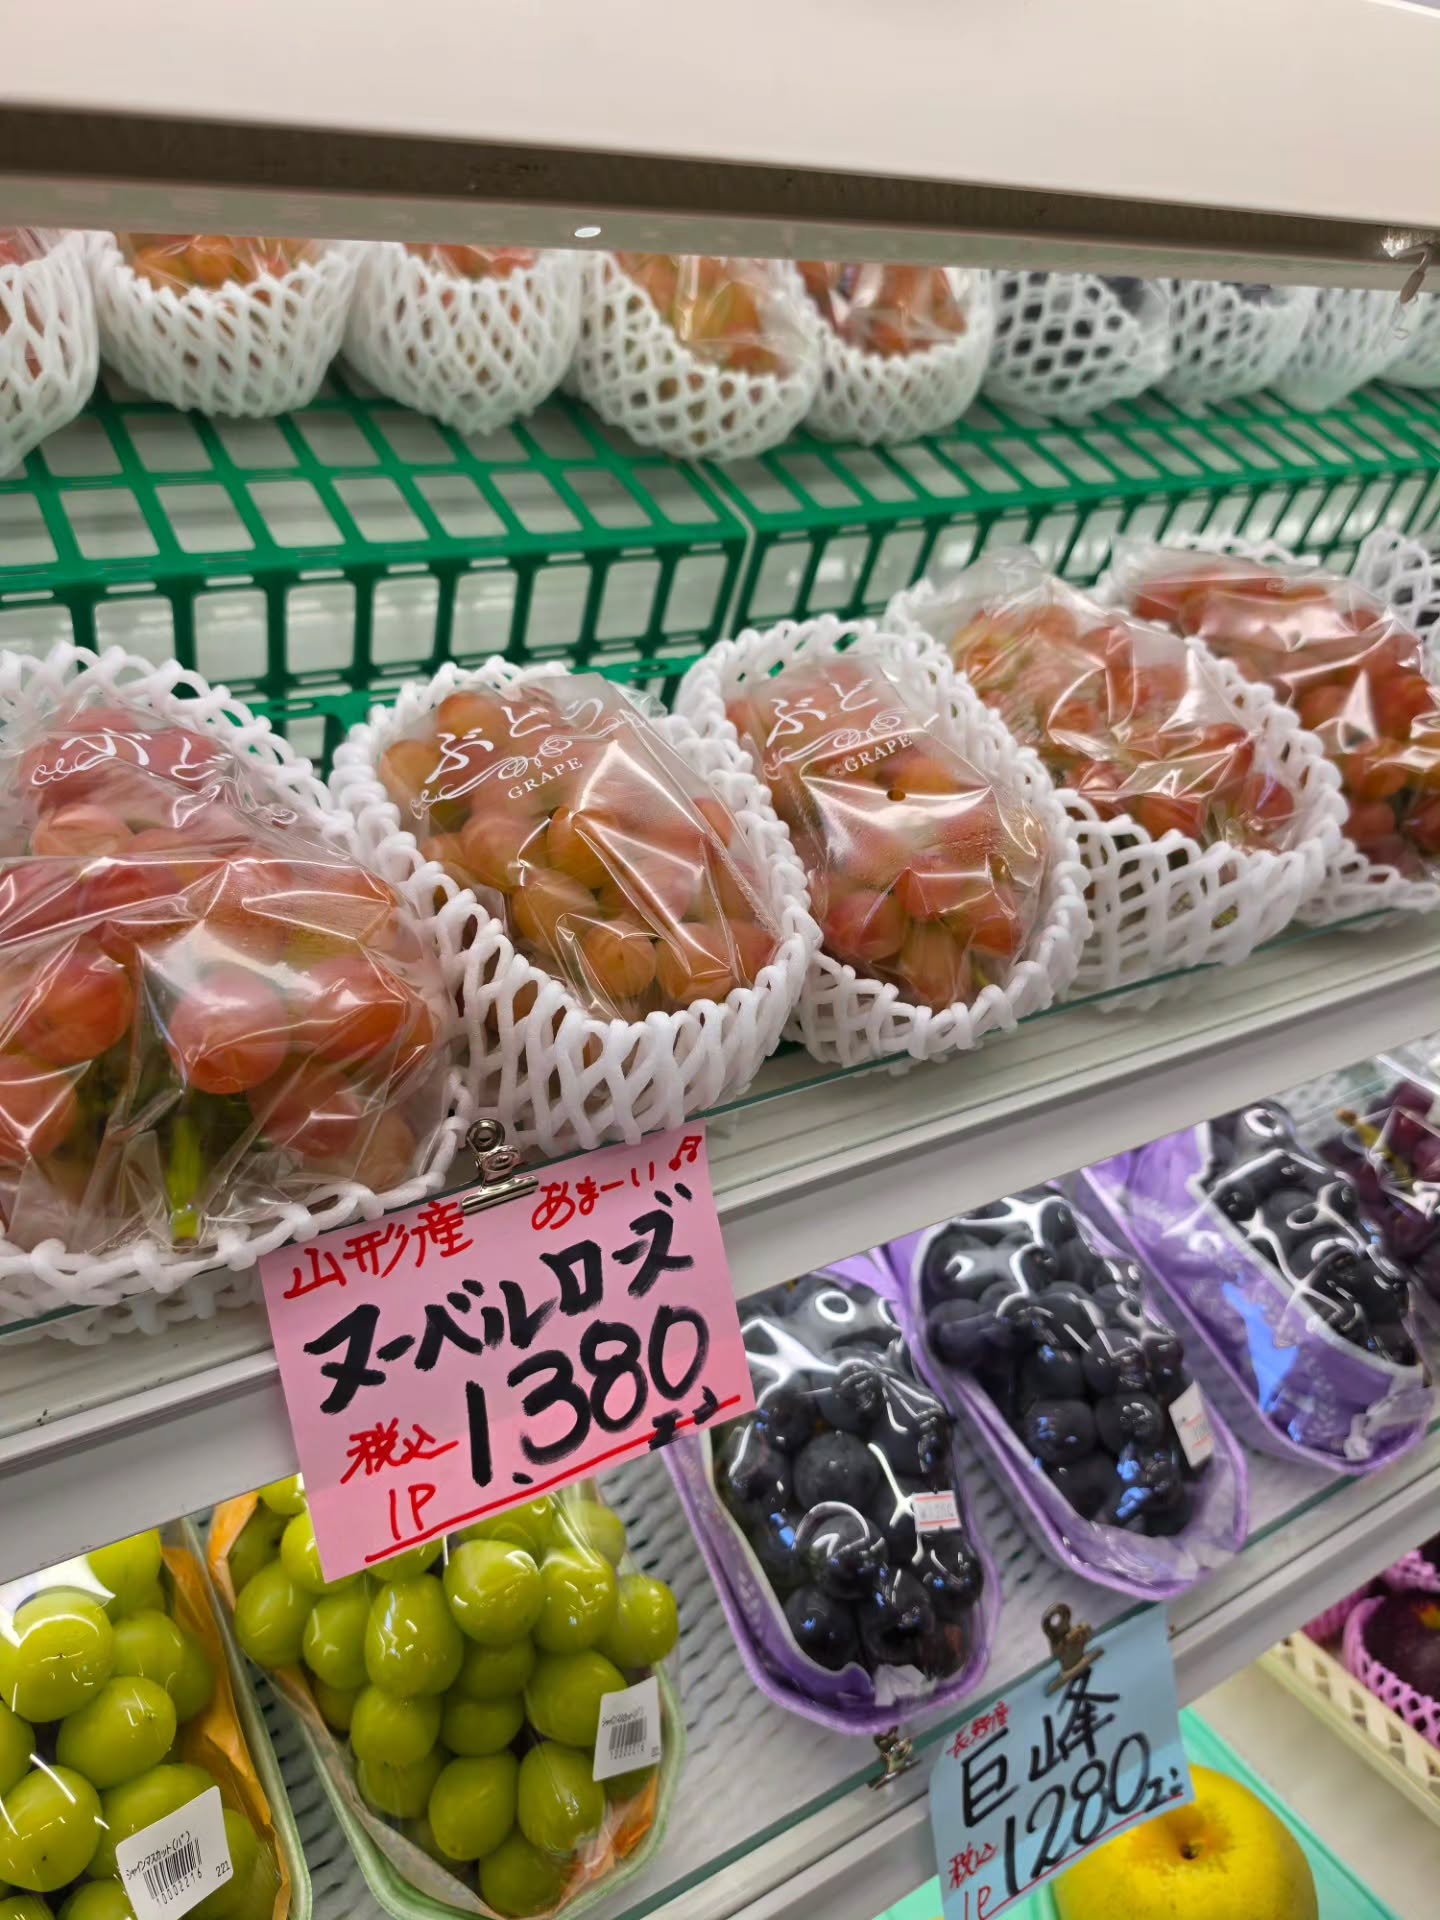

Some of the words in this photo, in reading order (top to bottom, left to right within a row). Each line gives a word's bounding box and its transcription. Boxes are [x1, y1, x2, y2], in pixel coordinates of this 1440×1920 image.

[507, 756, 583, 800] GRAPE
[844, 732, 914, 773] GRAPE
[284, 1201, 474, 1299] 山形産
[302, 1182, 695, 1415] ヌーベルローズ
[341, 1417, 459, 1484] 税込
[389, 1483, 436, 1541] 1P
[960, 1666, 1121, 1828] 巨峰
[215, 1860, 231, 1878] 221
